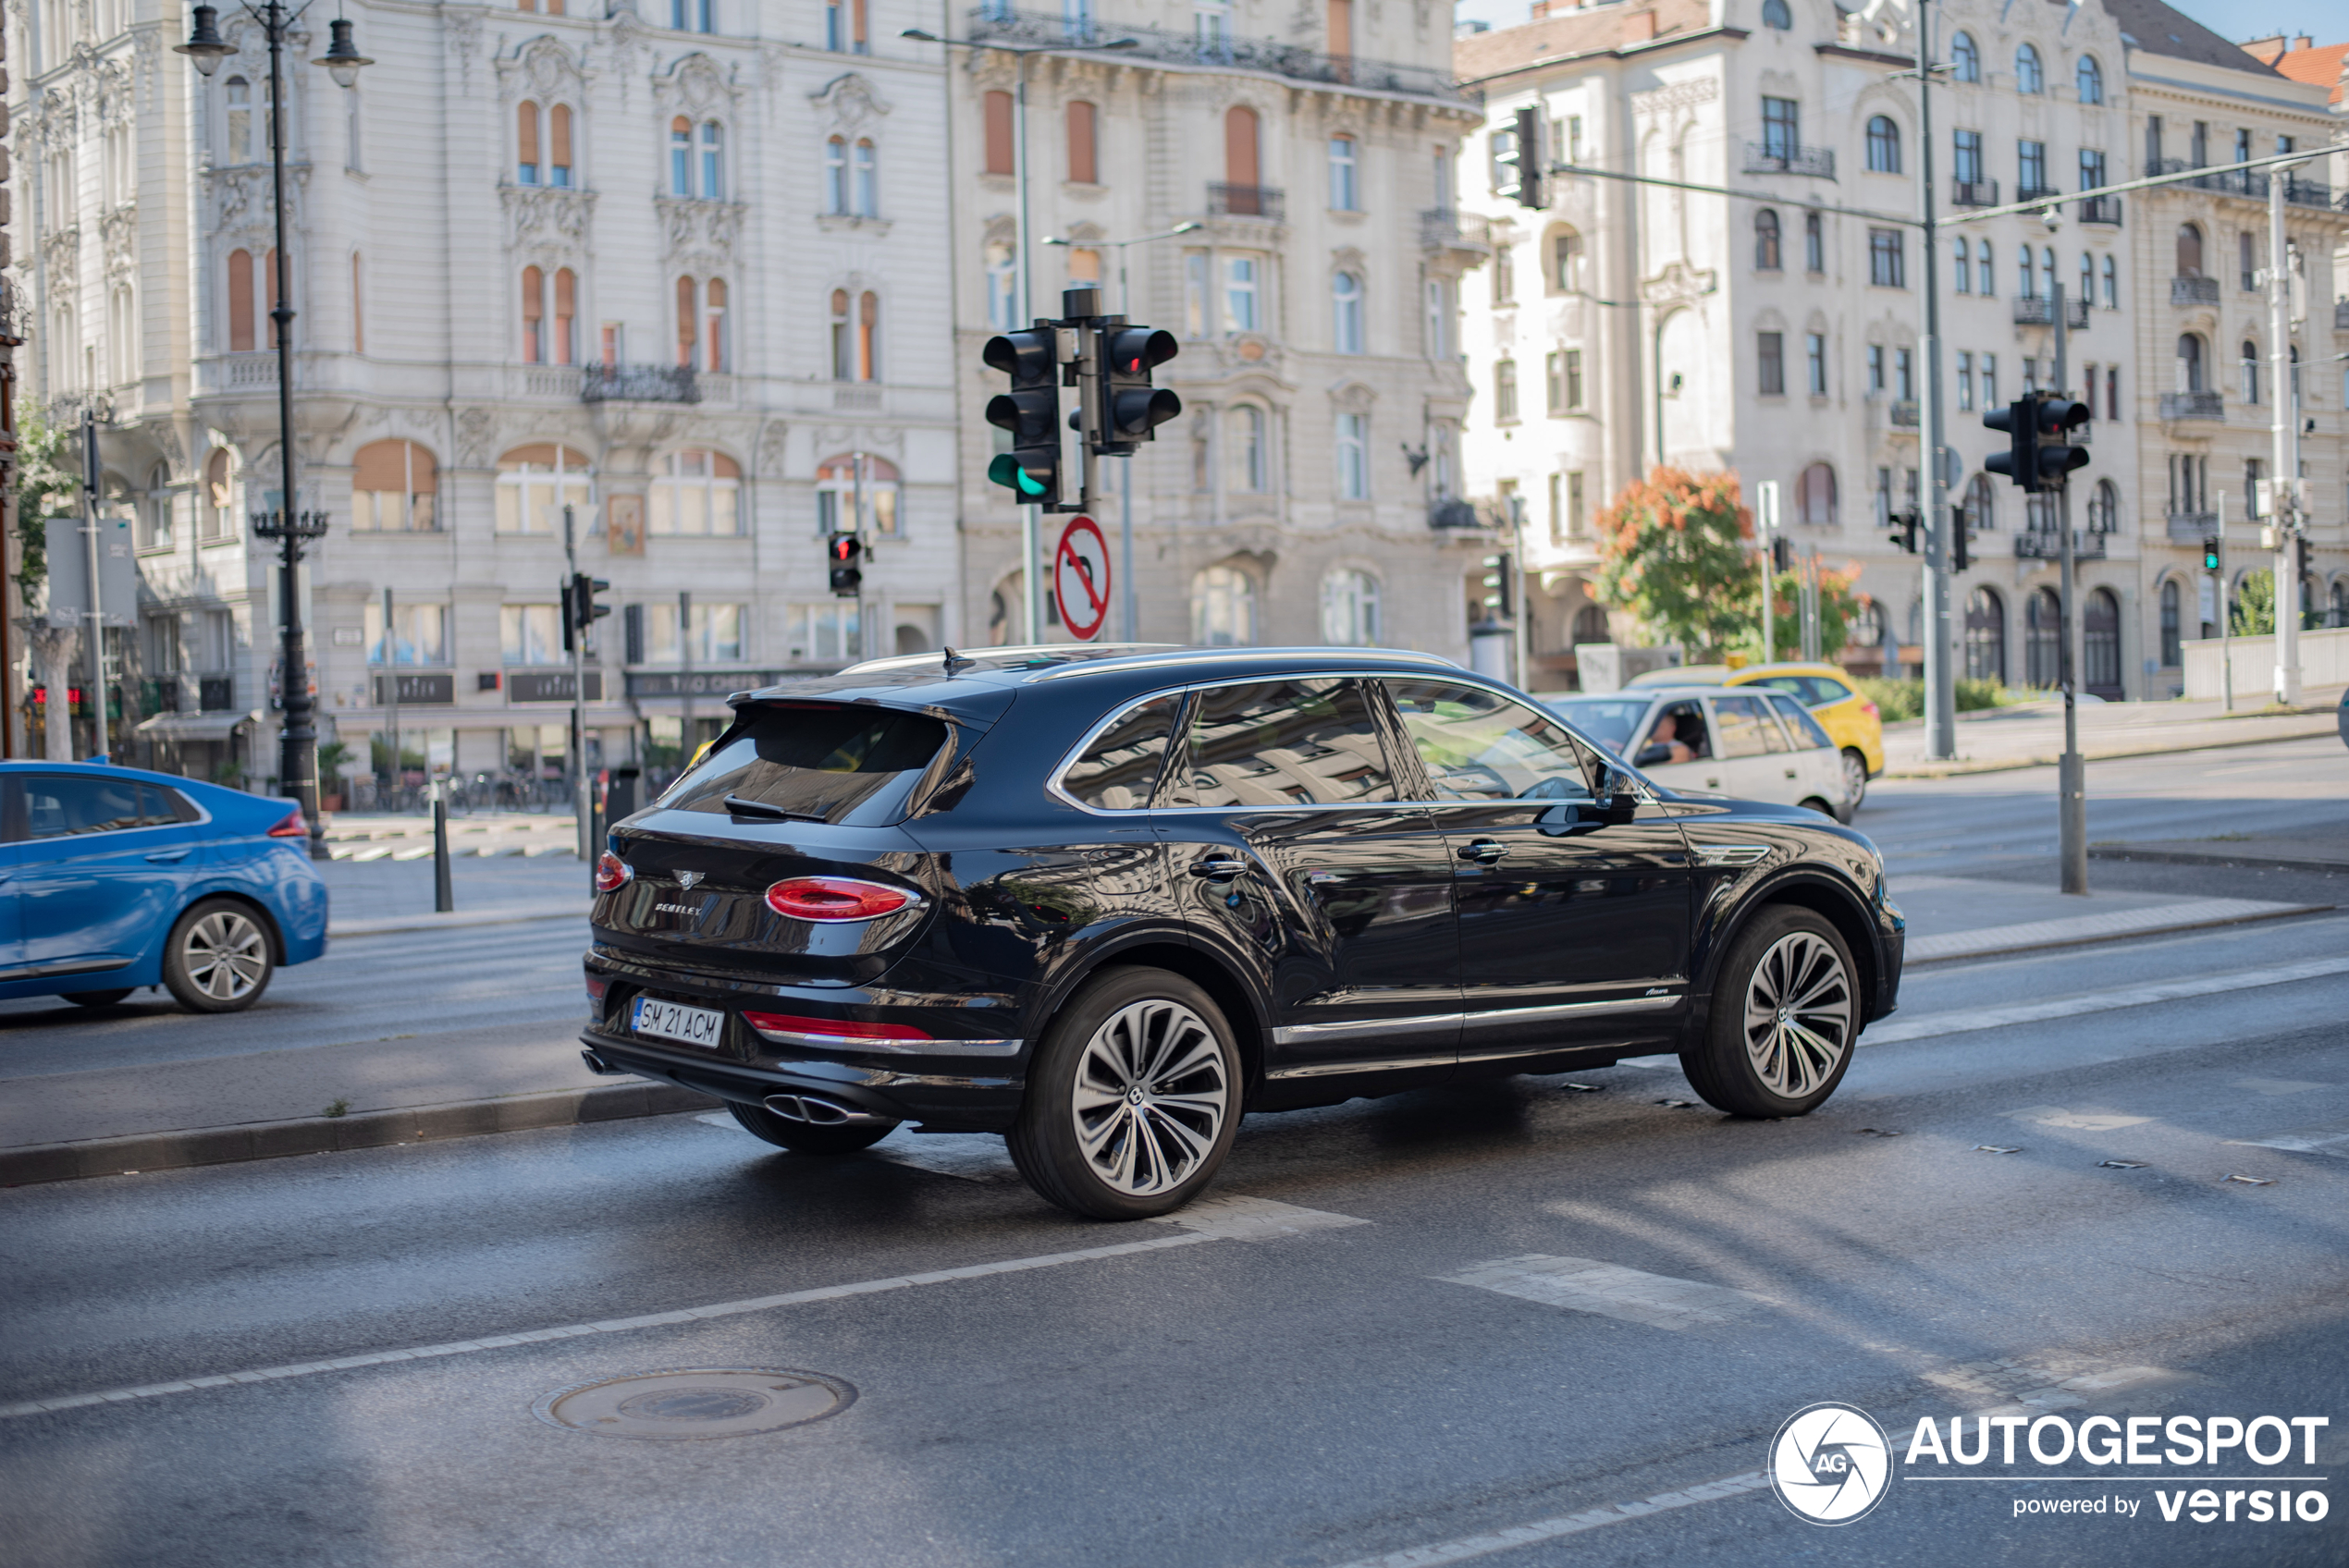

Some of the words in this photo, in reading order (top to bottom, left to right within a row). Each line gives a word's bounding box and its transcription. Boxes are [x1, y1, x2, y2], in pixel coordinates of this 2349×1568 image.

[655, 902, 702, 916] BENTLEY
[641, 1003, 663, 1031] SM
[665, 1008, 682, 1035] 21
[683, 1011, 717, 1042] ACM
